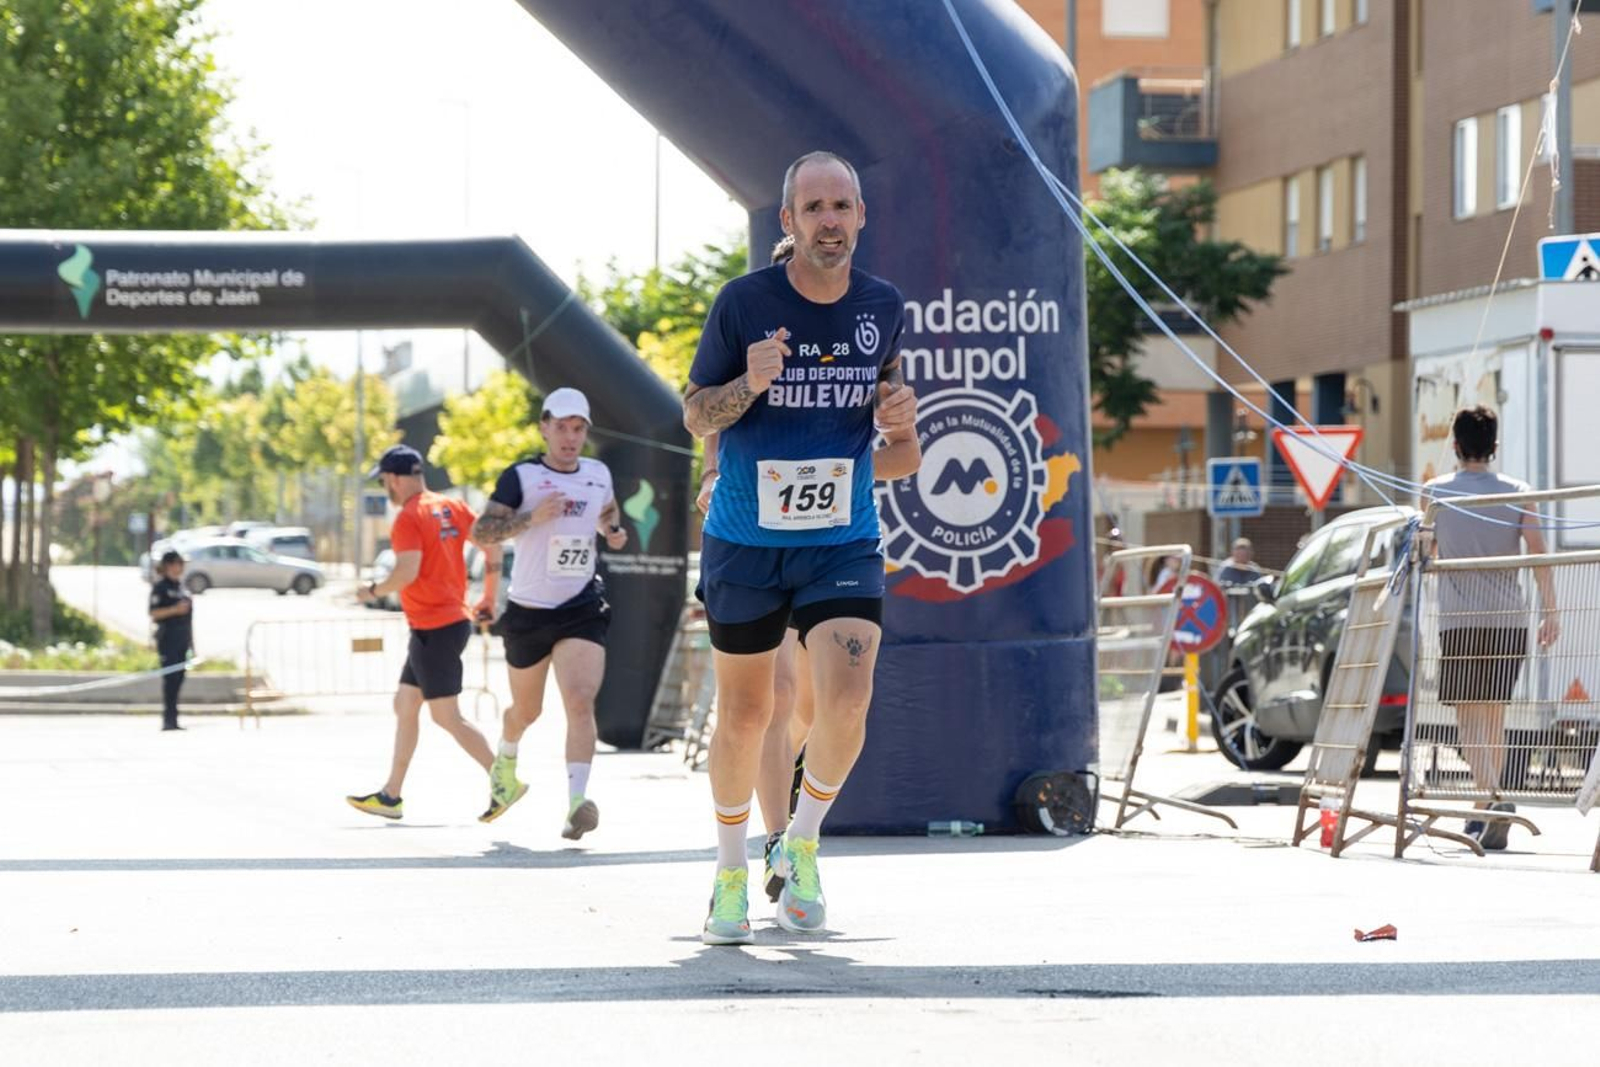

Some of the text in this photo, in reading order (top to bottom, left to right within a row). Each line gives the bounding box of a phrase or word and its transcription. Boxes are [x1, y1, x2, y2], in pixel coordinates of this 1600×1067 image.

[105, 269, 305, 289] Patronato Municipal de
[105, 288, 260, 308] Deportes de Jaén
[902, 288, 1059, 334] ndación
[799, 342, 850, 357] RA 28
[900, 336, 1026, 391] mupol
[773, 366, 877, 382] LUB DEPORTIVO
[929, 414, 1023, 489] de la Mutualidad de la
[778, 481, 836, 512] 159
[931, 525, 997, 546] POLICÍA
[557, 549, 589, 566] 578
